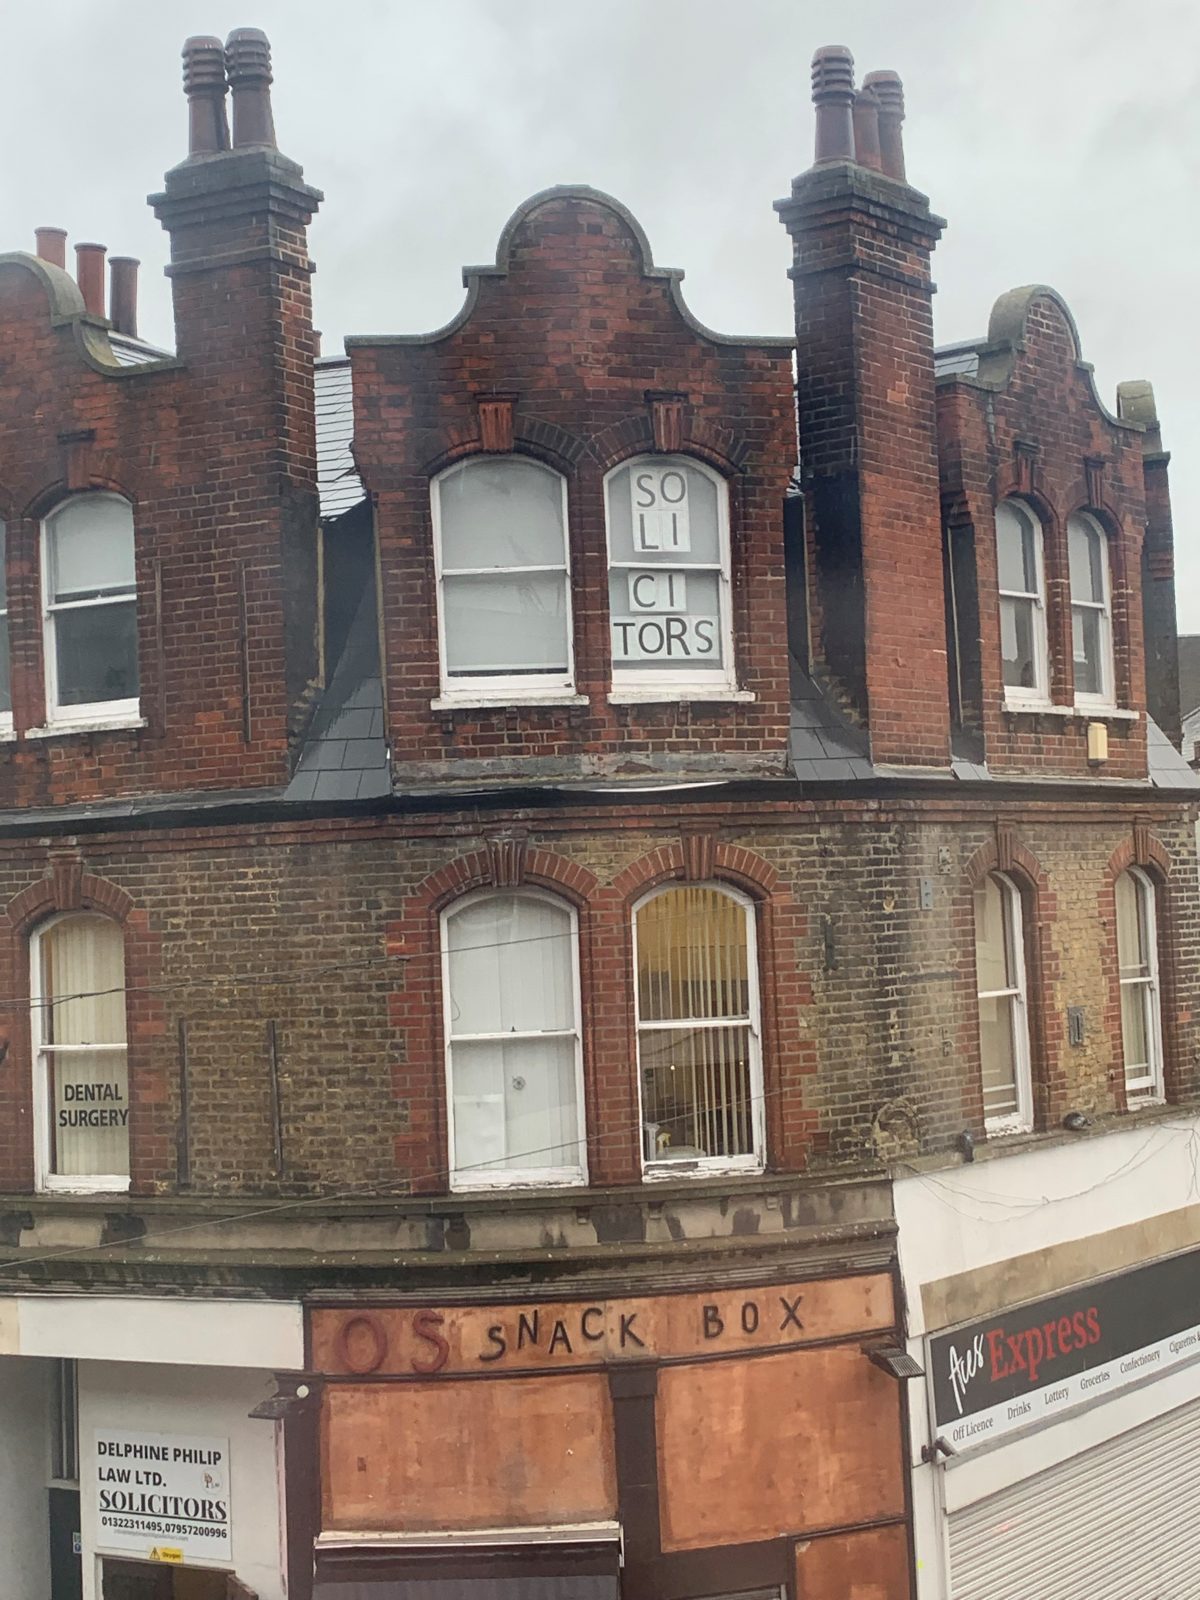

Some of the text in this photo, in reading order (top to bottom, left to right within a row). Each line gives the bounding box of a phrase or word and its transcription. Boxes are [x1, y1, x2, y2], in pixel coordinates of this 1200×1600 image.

[636, 471, 686, 508] SO
[639, 512, 679, 550] LI
[632, 574, 675, 608] CI
[613, 617, 714, 656] TORS
[64, 1083, 123, 1101] DENTAL
[59, 1108, 129, 1127] SURGERY
[479, 1307, 645, 1362] SNACK
[703, 1296, 804, 1339] BOX
[986, 1307, 1102, 1383] Express
[953, 1422, 966, 1441] Off
[966, 1416, 993, 1434] Licence
[1007, 1401, 1032, 1420] Drinks
[1044, 1387, 1070, 1405] Lottery
[1080, 1370, 1111, 1390] Groceries
[1120, 1350, 1161, 1374] Confectionery
[1169, 1334, 1197, 1354] Cigarettes
[97, 1441, 222, 1465] DELPHINE PHILIP
[98, 1466, 167, 1487] LAW LTD.
[99, 1489, 228, 1520] SOLICITORS
